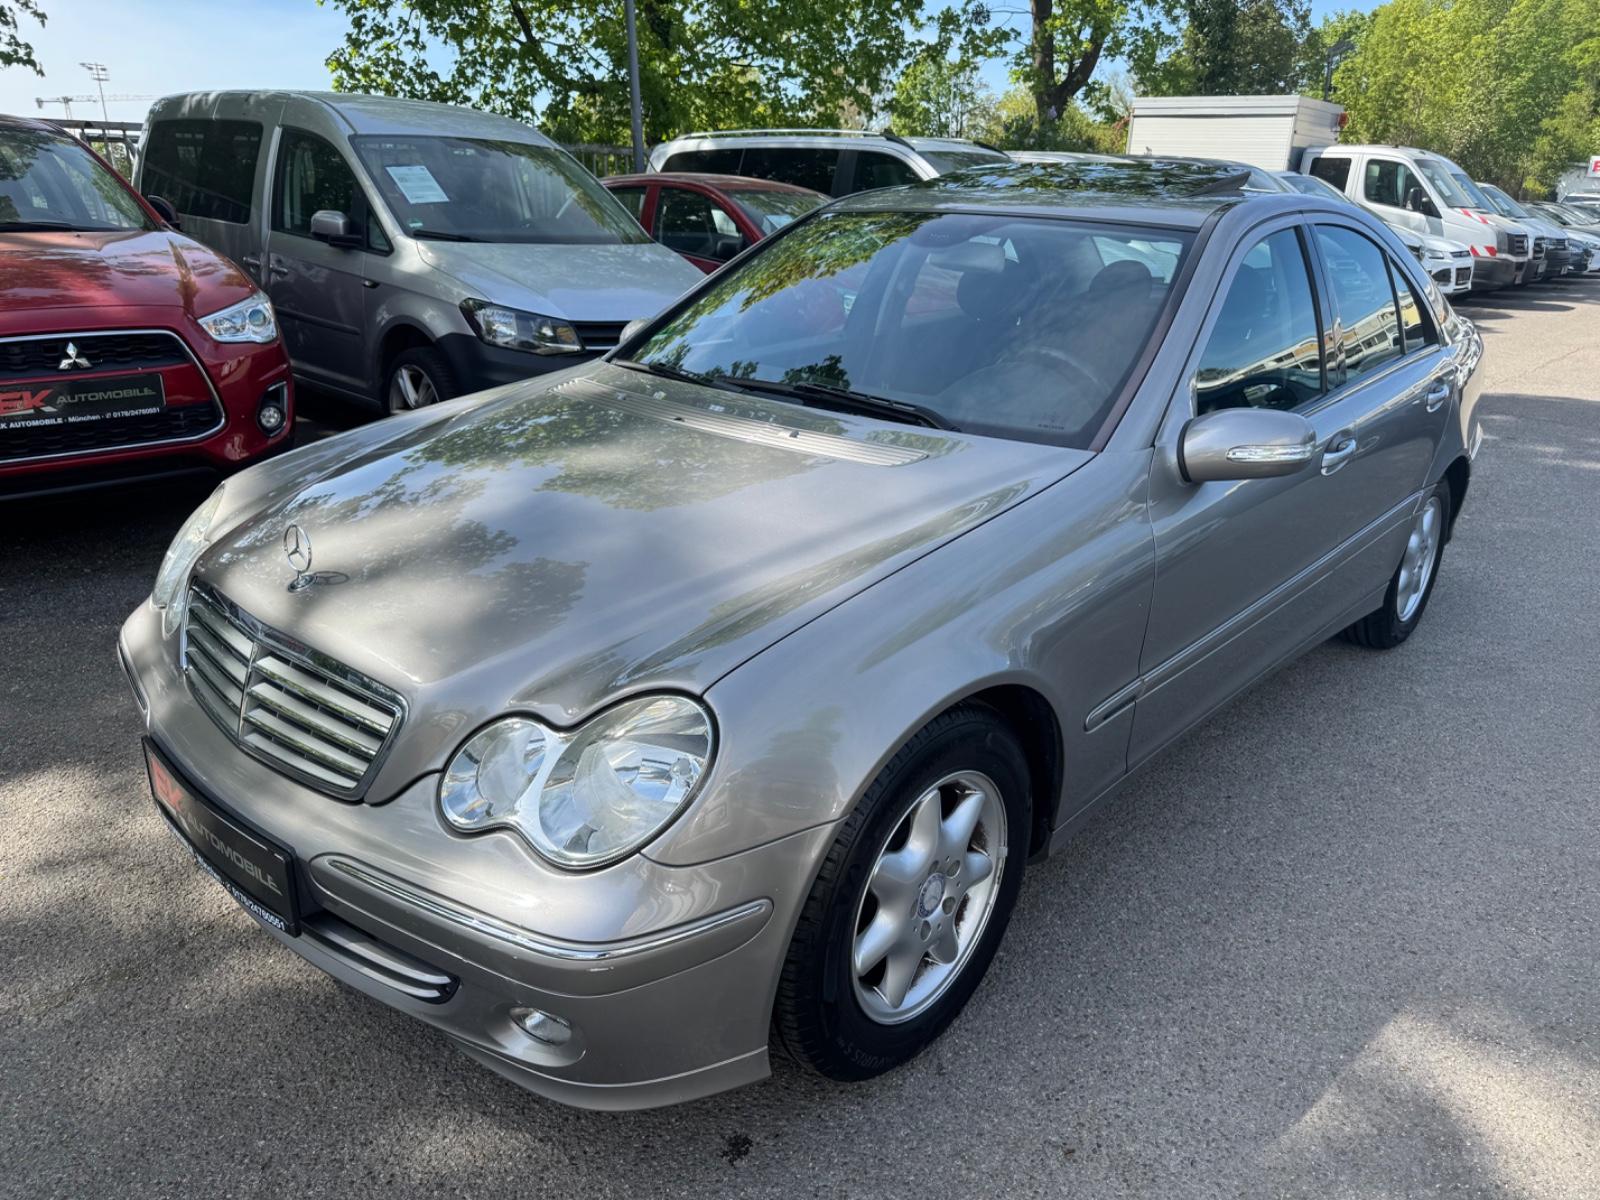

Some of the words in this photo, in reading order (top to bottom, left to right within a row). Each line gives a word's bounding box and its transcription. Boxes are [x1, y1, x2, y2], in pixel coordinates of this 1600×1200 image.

[56, 387, 156, 404] AUTOMOBILE
[9, 418, 63, 429] AUTOMOBILE
[68, 414, 101, 423] München
[187, 812, 283, 896] AUTOMOBILE
